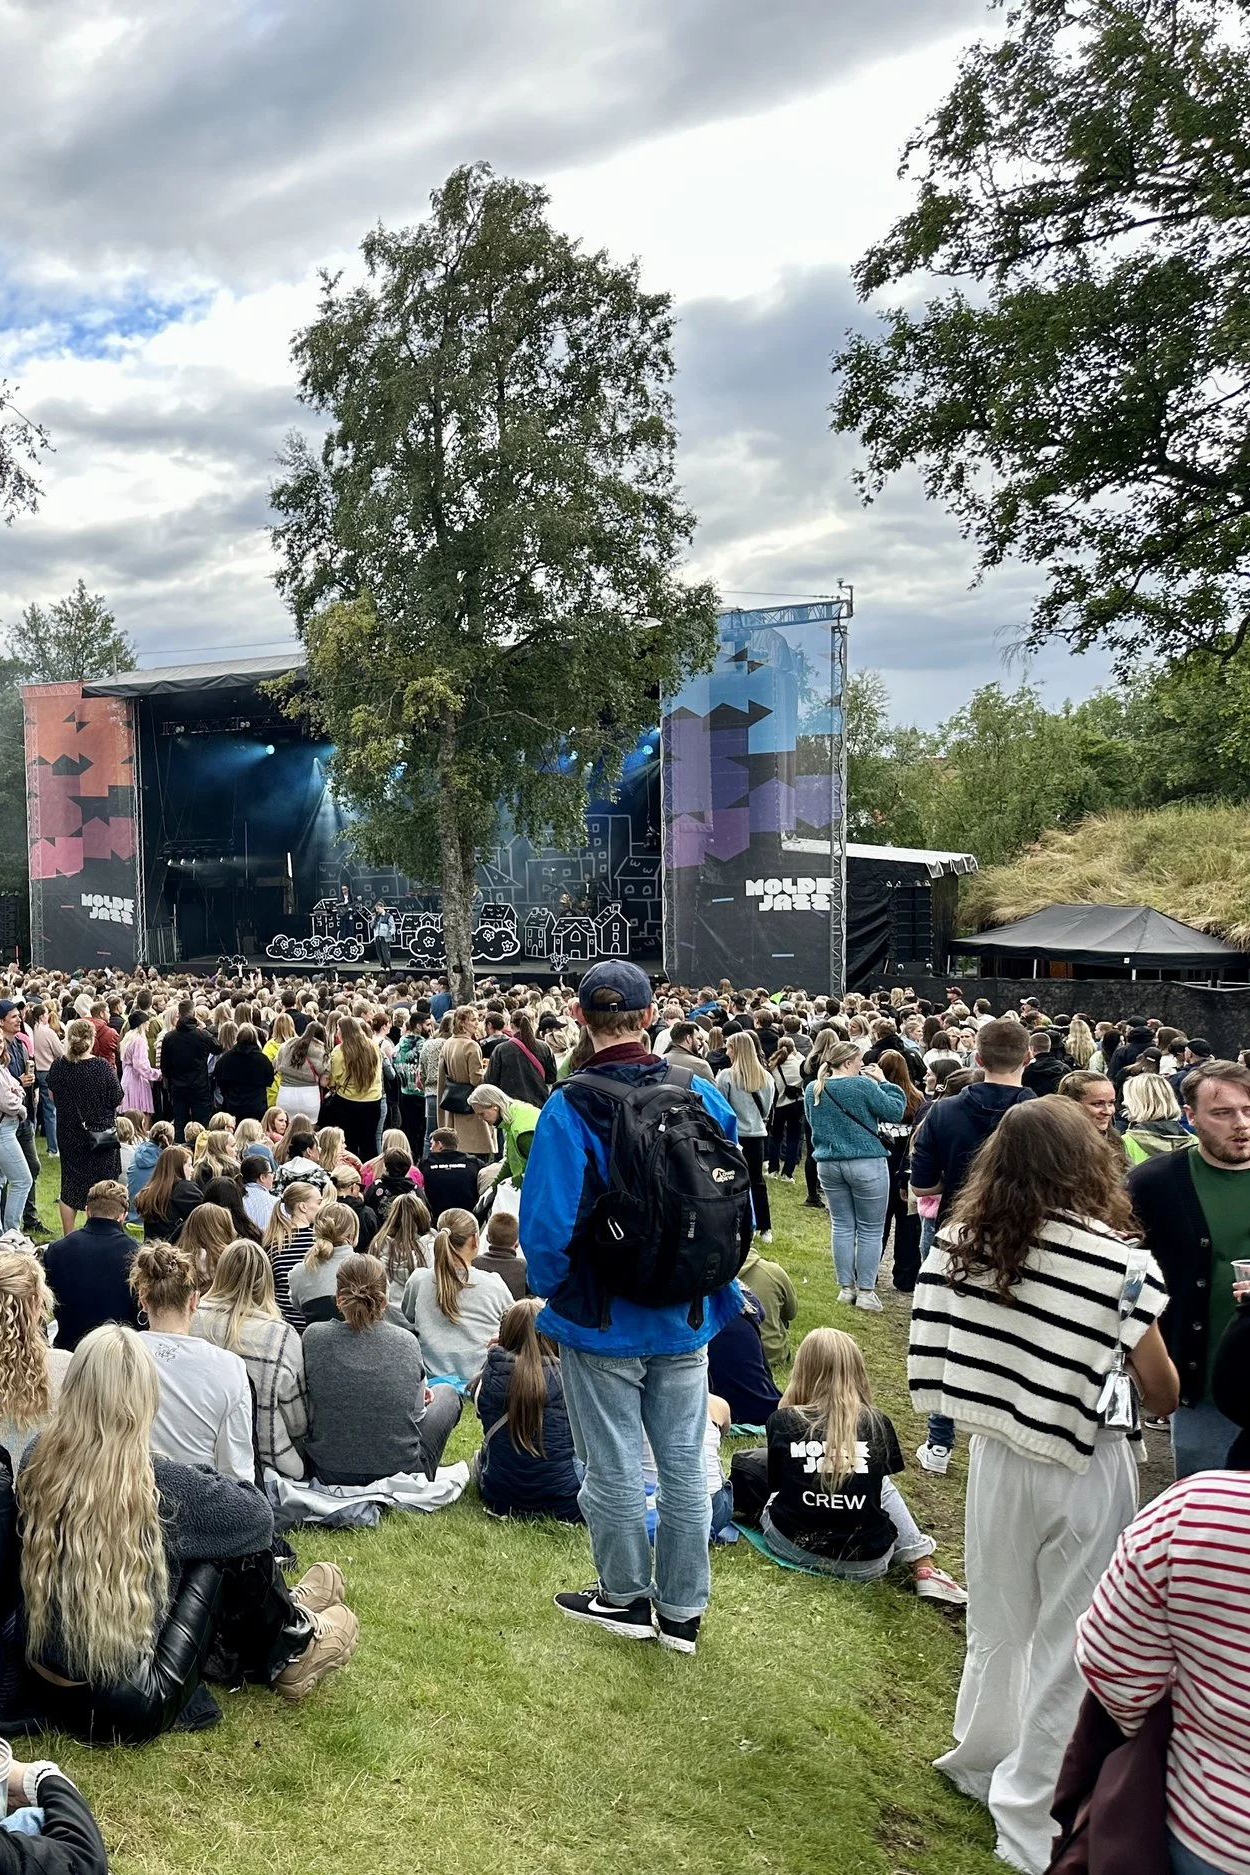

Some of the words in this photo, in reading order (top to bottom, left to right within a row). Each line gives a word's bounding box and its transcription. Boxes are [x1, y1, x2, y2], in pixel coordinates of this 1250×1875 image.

[745, 877, 835, 897] MOLDE
[81, 893, 135, 914] MOLDE
[758, 893, 831, 912] JAZZ
[89, 906, 134, 926] JAZZ
[790, 1440, 871, 1458] MOE
[802, 1490, 867, 1510] CREW
